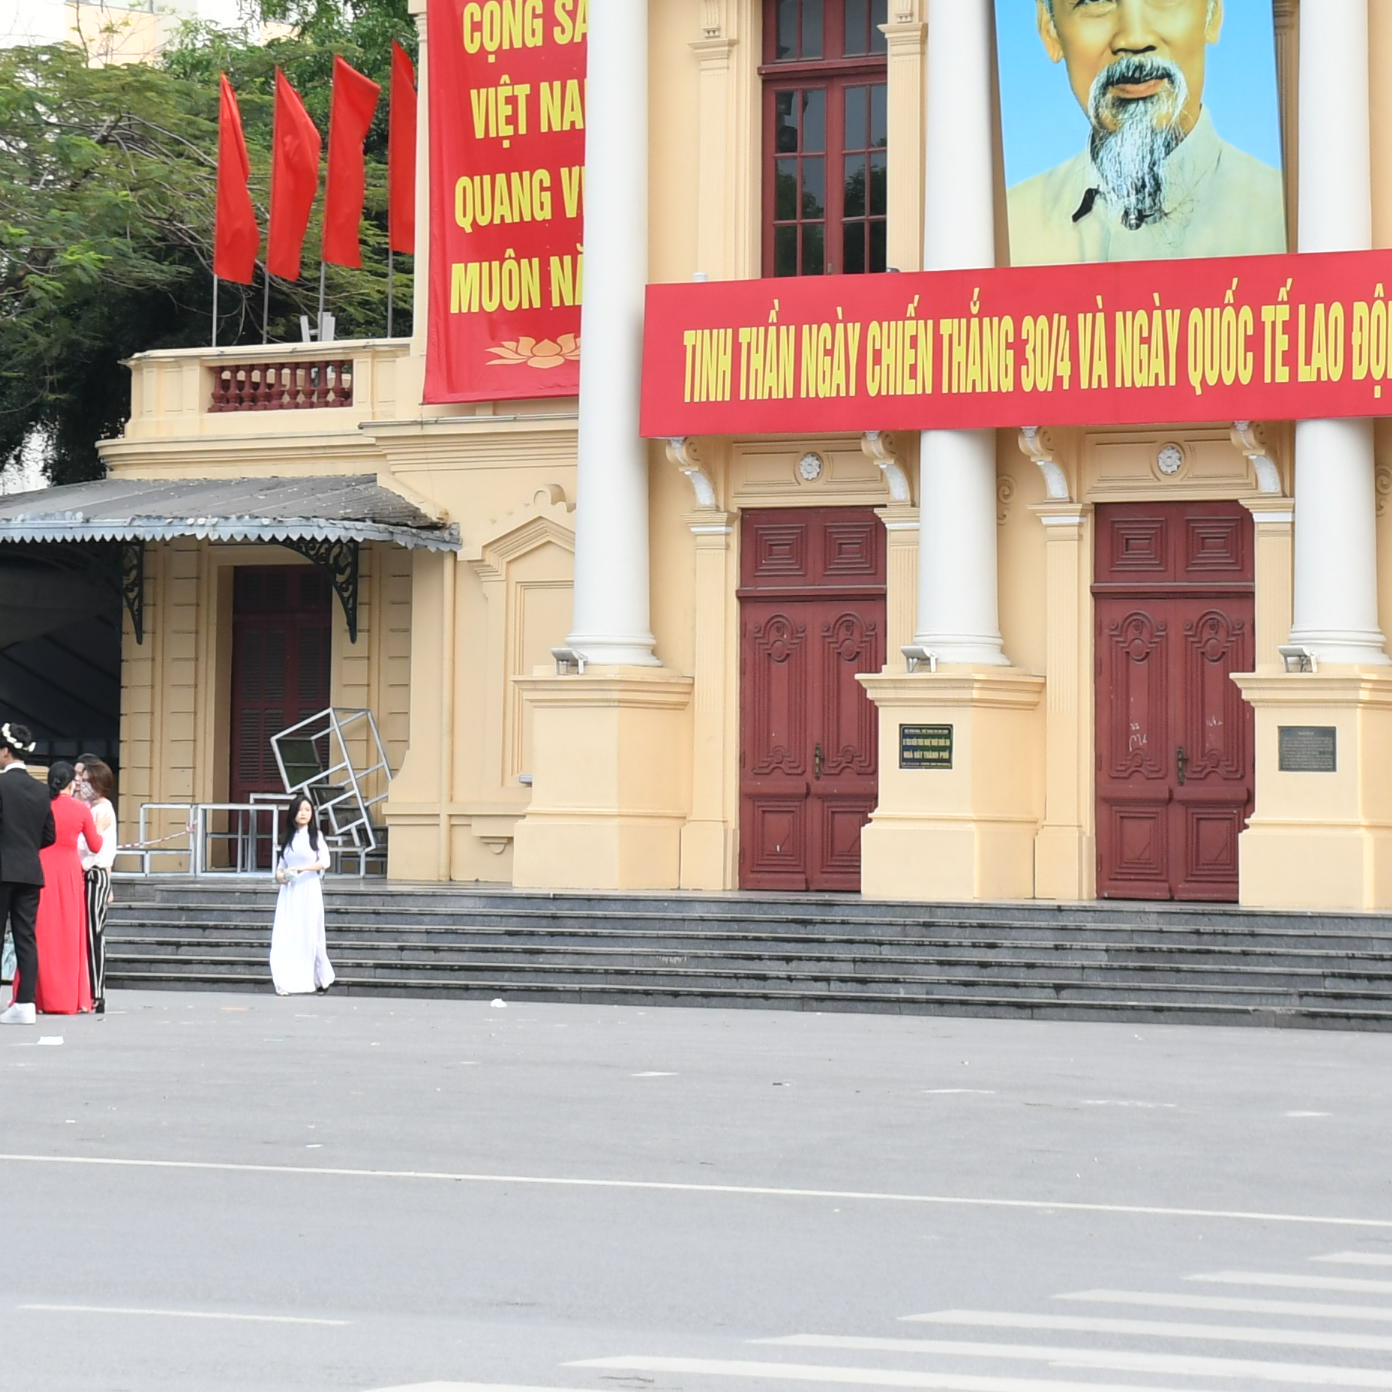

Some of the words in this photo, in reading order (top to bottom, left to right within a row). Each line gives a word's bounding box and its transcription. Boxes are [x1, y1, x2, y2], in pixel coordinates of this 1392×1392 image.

[470, 74, 532, 149] VIỆT
[539, 78, 587, 133] NA
[454, 168, 553, 235] QUANG
[449, 248, 541, 314] MUÔN
[682, 326, 734, 404] TINH
[738, 298, 796, 401] THẦN
[799, 305, 862, 399] NGÀY
[865, 294, 935, 398] CHIẾN
[939, 286, 1015, 395] THẮNG
[1020, 312, 1072, 393] 30/4
[1076, 295, 1110, 390] VÀ
[1114, 292, 1181, 389] NGÀY
[1187, 277, 1255, 396] QUỐC
[1260, 277, 1294, 384] TẾ
[1296, 301, 1346, 383] LAO
